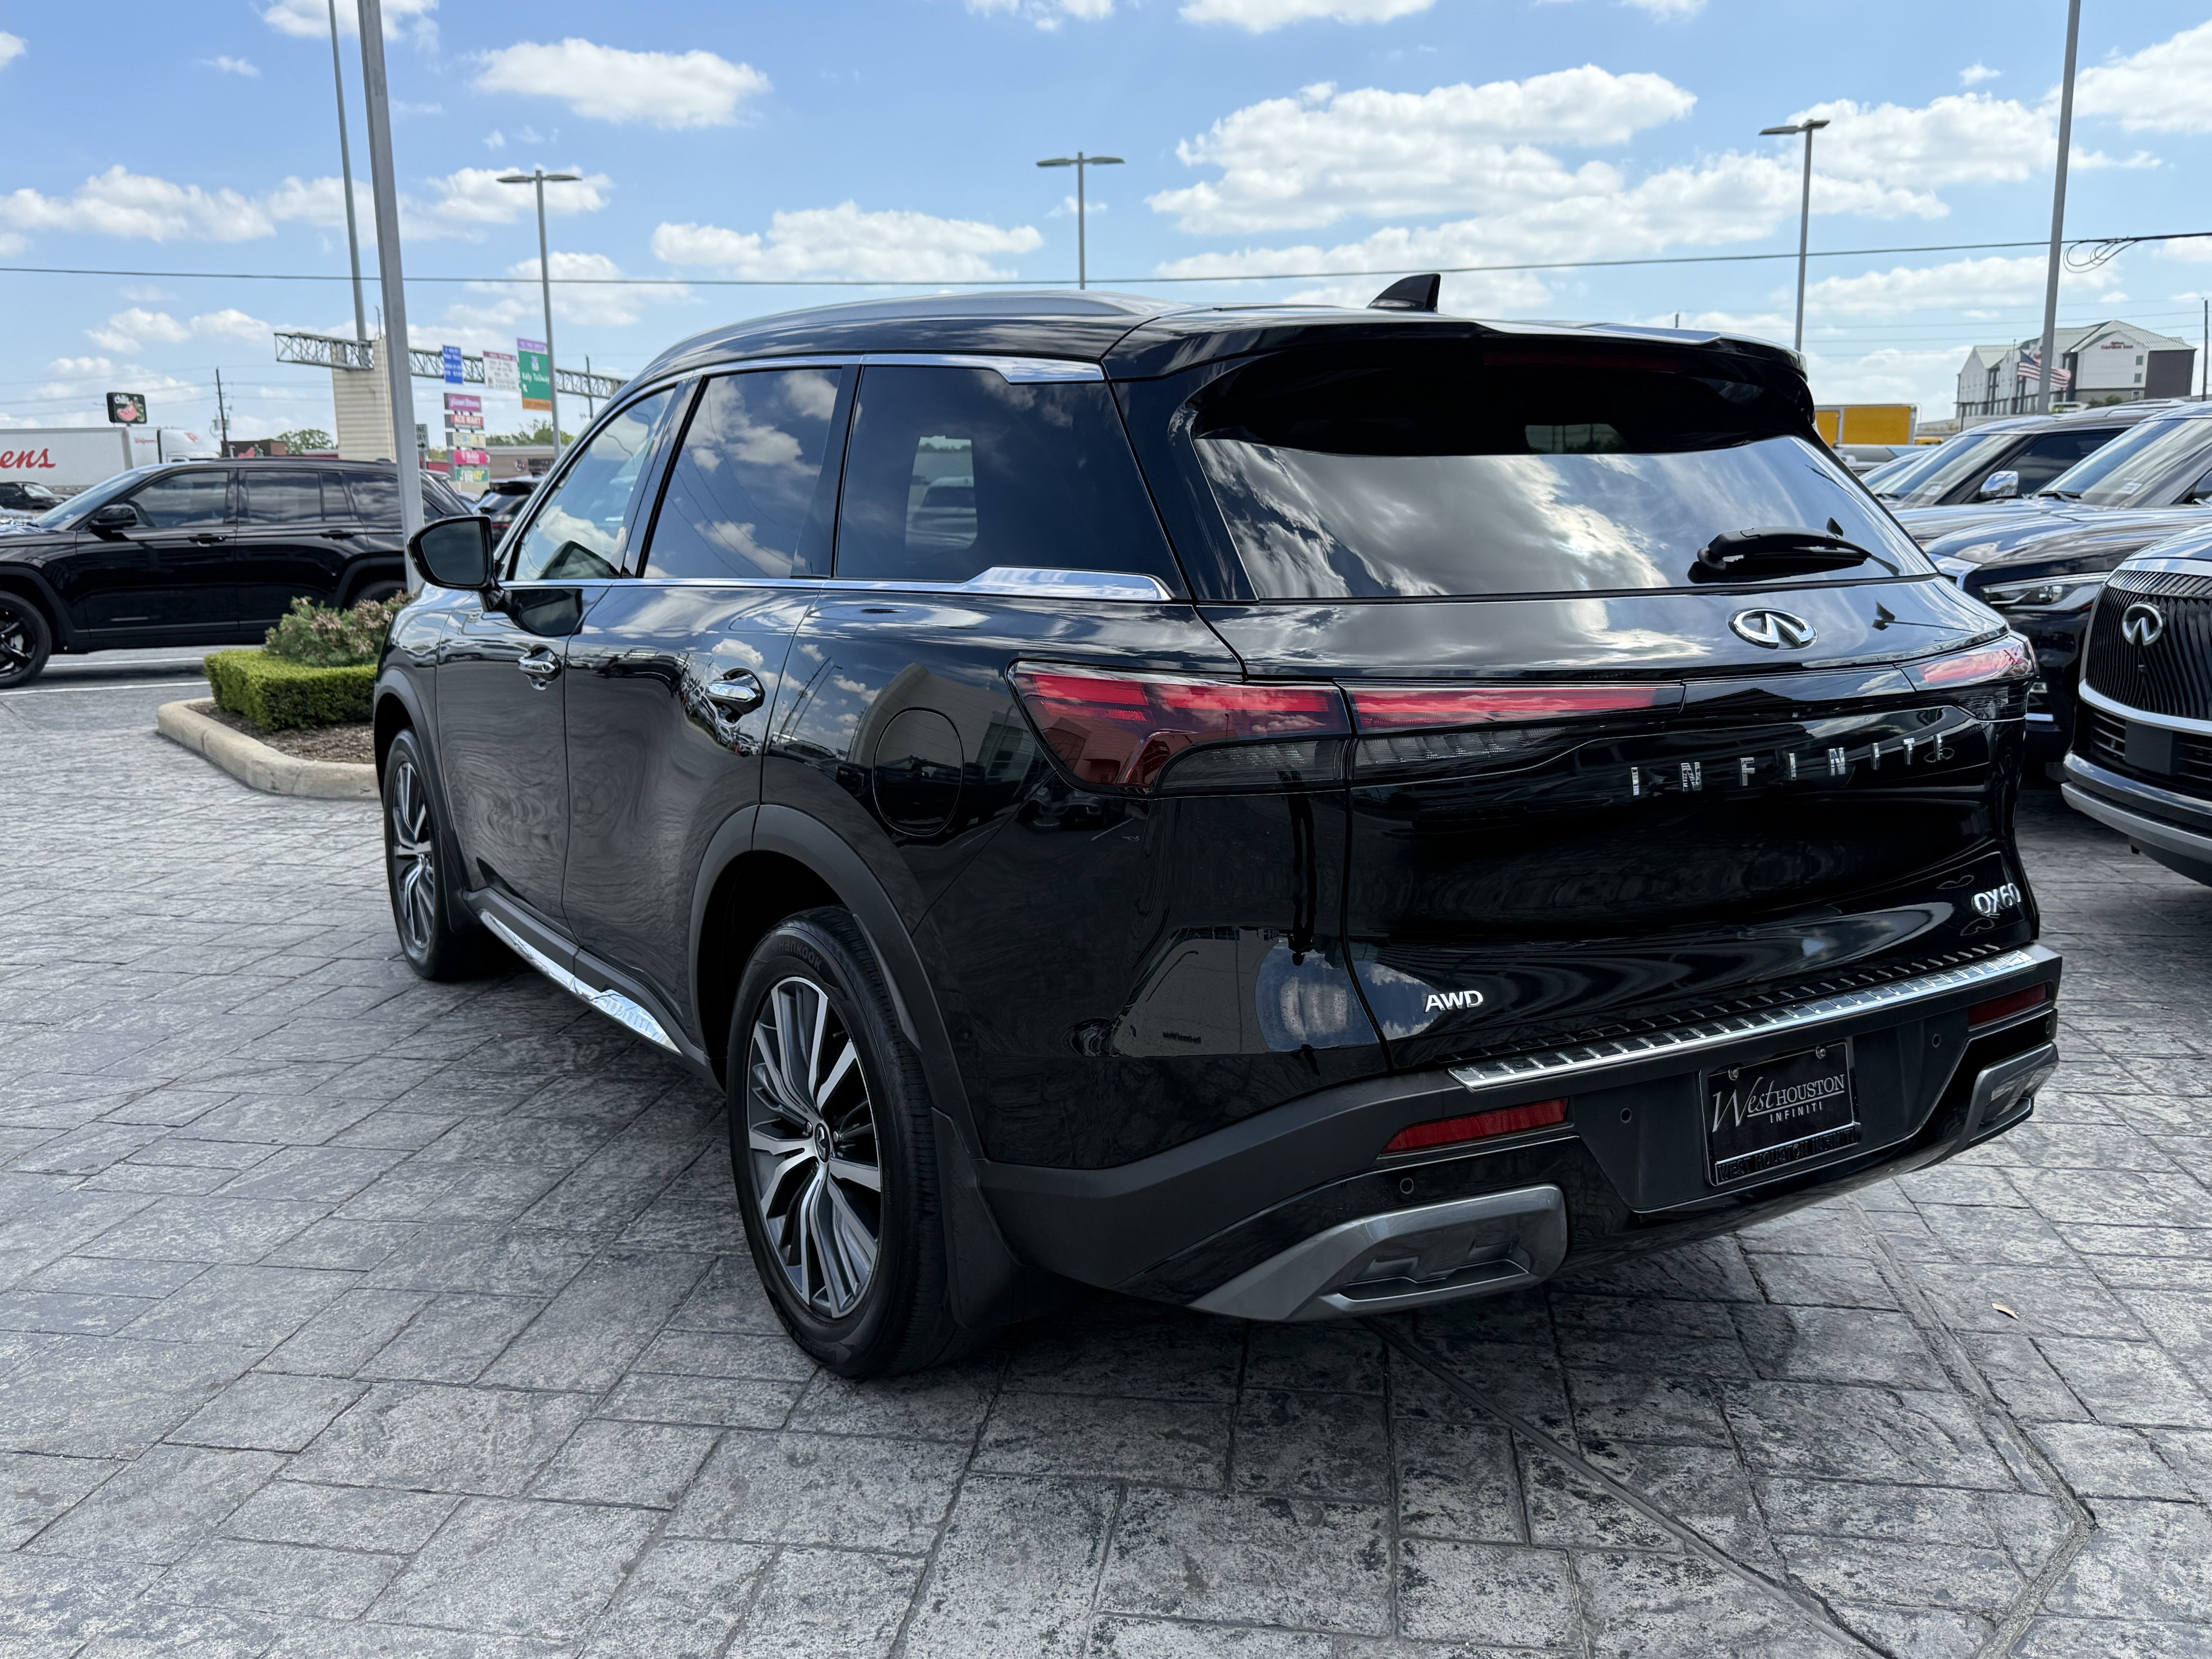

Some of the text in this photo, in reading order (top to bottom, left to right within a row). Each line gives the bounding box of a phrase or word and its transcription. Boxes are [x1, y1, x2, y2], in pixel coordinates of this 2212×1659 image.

[1631, 734, 1942, 796] INFINITI
[1972, 883, 2021, 918] QX60
[1425, 990, 1483, 1012] AWD
[1770, 1101, 1822, 1123] INFINITI
[1718, 1127, 1854, 1181] WEST HOUSTON INFINITI
